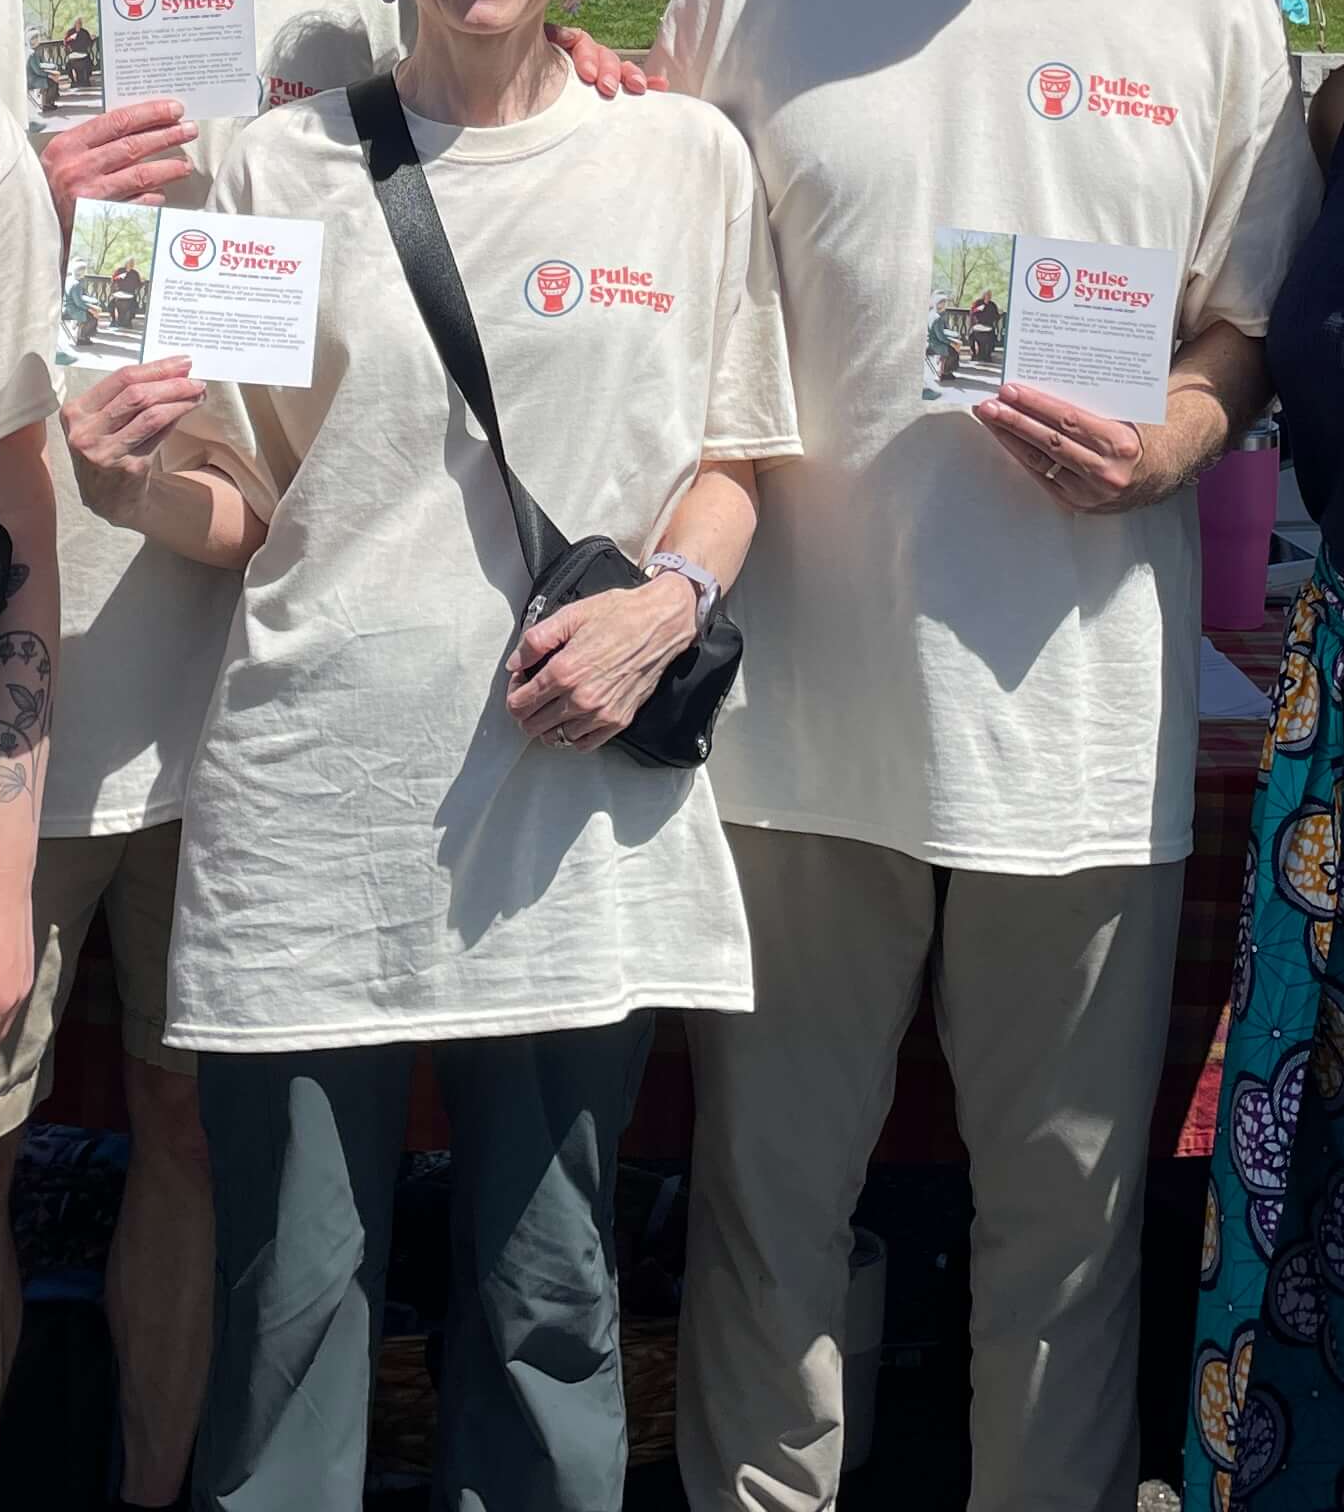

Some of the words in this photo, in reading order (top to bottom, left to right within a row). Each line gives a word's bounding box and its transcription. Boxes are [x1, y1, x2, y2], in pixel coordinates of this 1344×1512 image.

[270, 77, 320, 99] Puls
[1089, 74, 1151, 99] Pulse
[1088, 94, 1179, 127] Synergy
[222, 239, 275, 256] Pulse
[219, 253, 302, 275] Synergy
[590, 265, 653, 287] Pulse
[1075, 268, 1129, 288] Pulse
[589, 286, 676, 314] Synergy
[1073, 284, 1155, 308] Synergy
